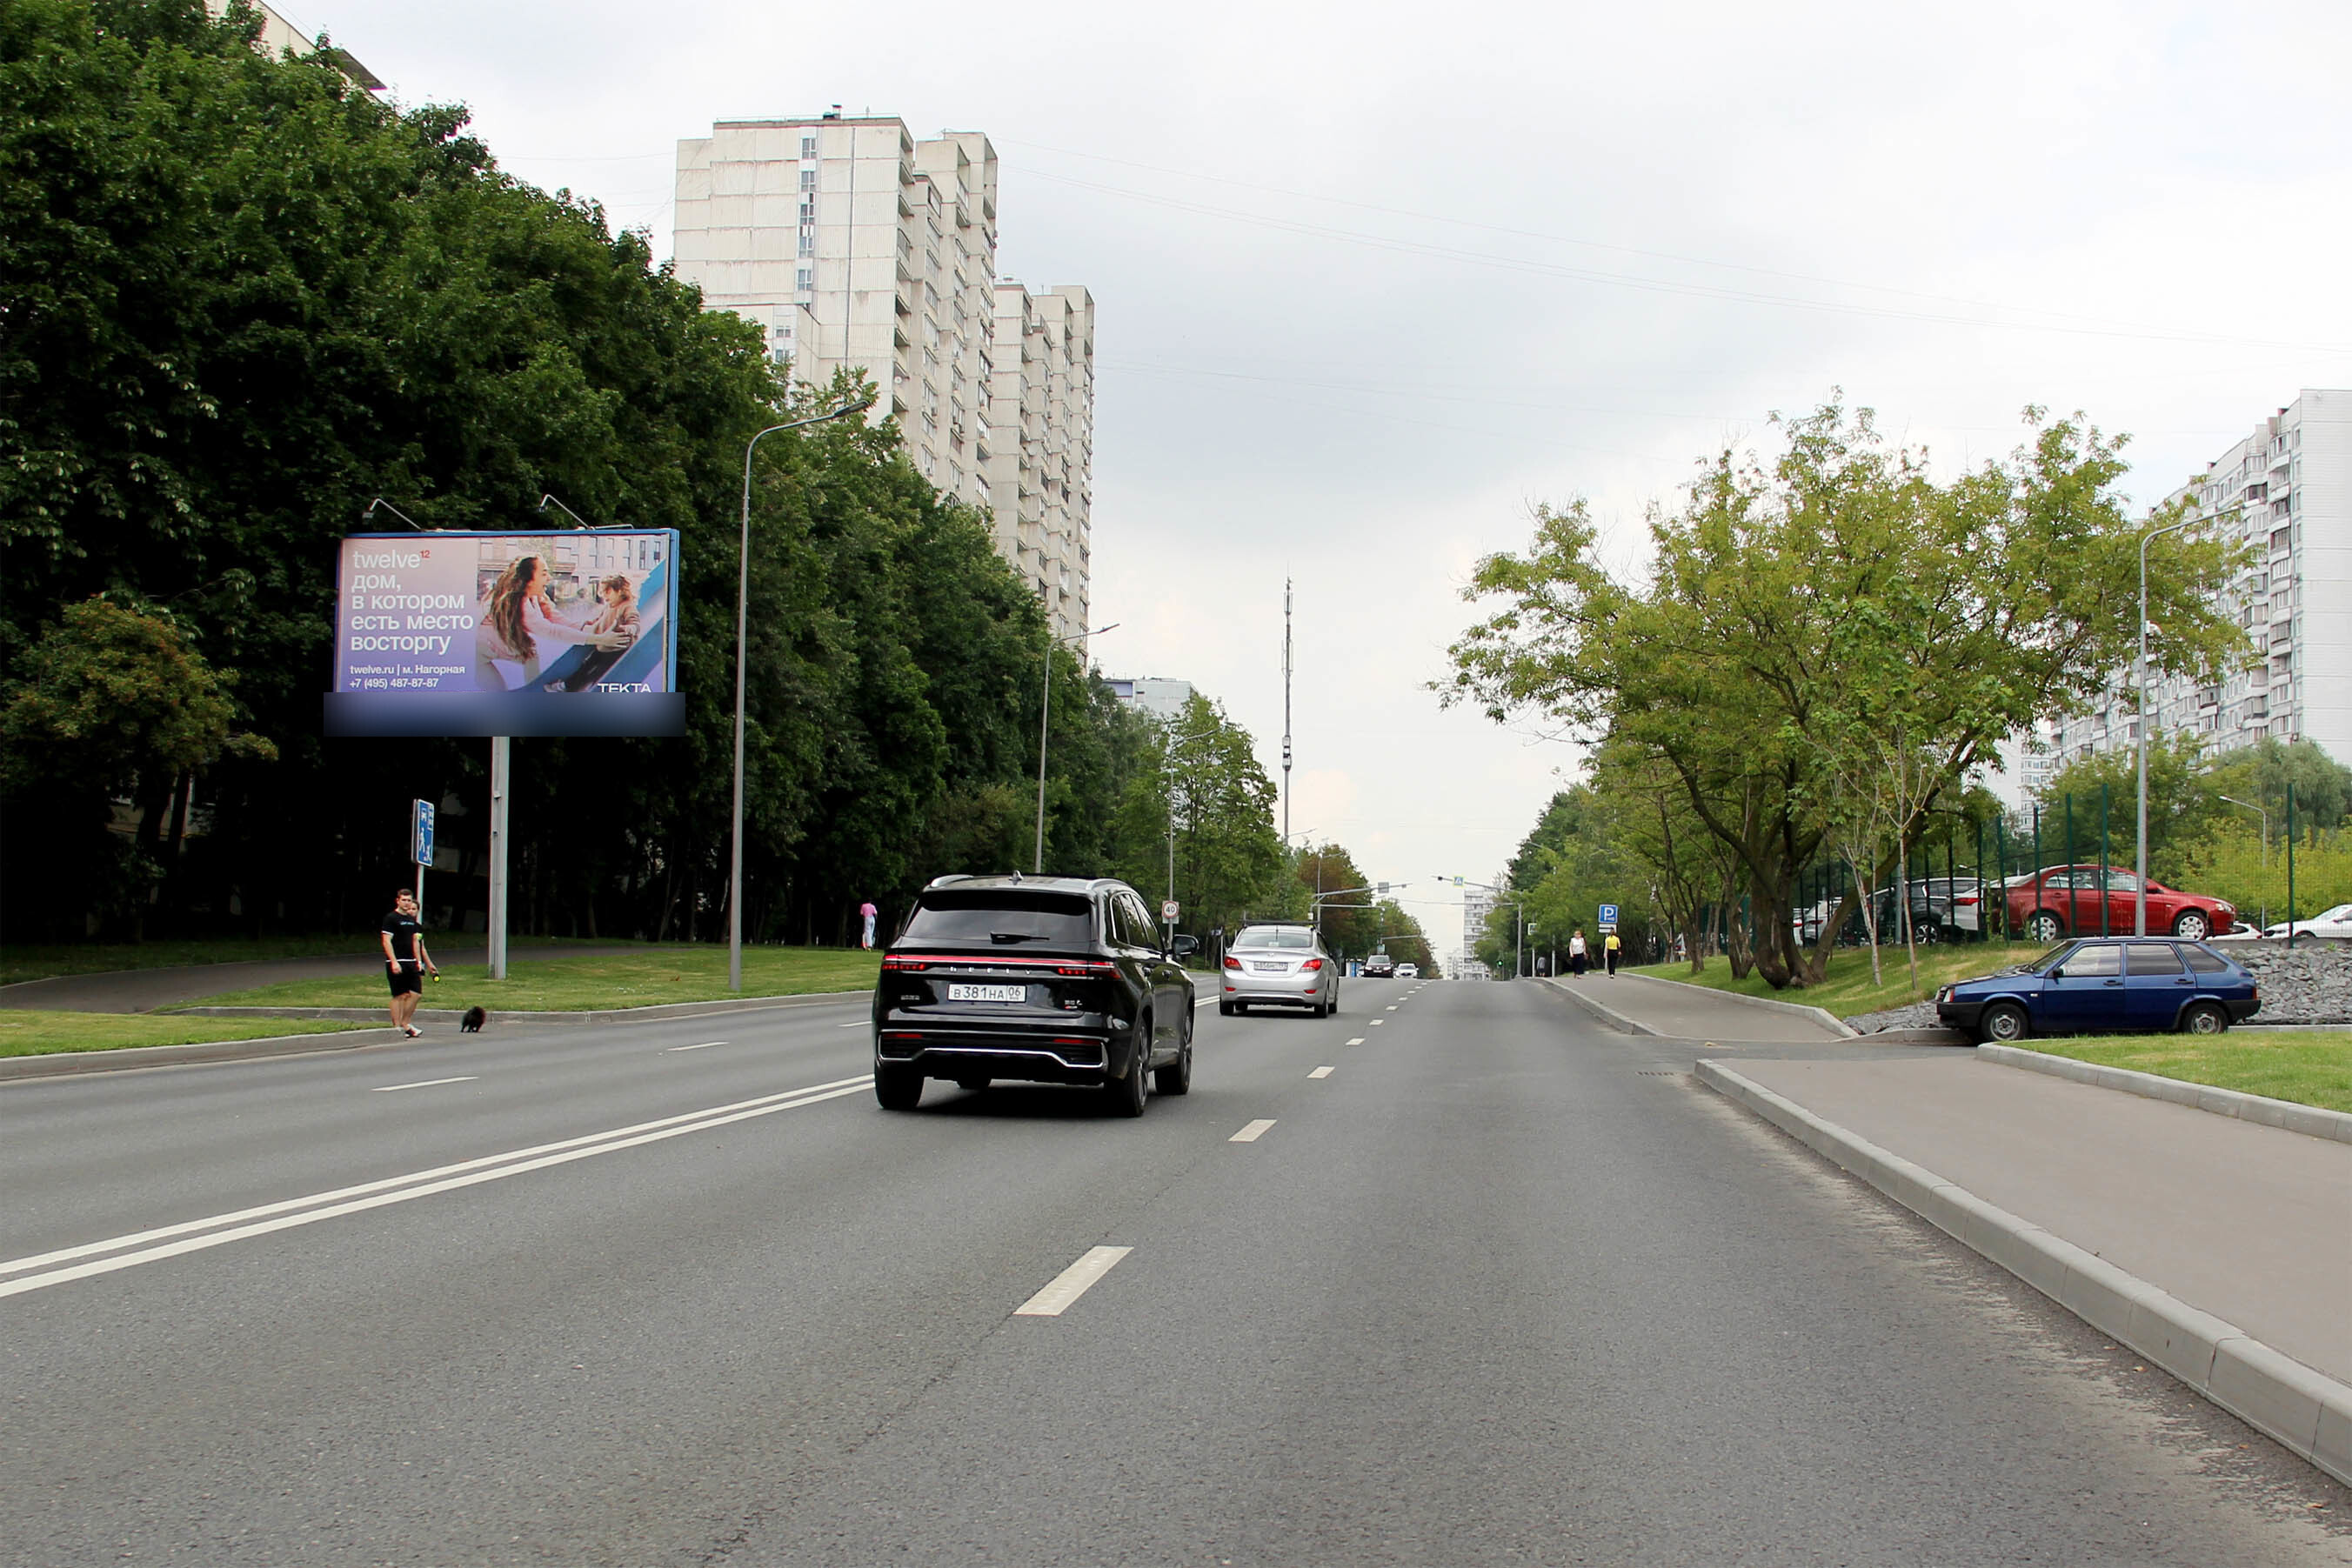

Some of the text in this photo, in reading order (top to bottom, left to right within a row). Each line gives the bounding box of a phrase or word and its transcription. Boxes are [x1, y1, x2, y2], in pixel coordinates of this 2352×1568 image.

[352, 549, 420, 568] twelve
[351, 575, 401, 593] дом,
[352, 595, 464, 614] в котором
[351, 615, 473, 630] есть место
[351, 636, 451, 655] восторгу
[350, 665, 394, 674] twelve.ru
[415, 665, 465, 677] Нагорная
[350, 678, 438, 689] +7 (495) 487-87-87
